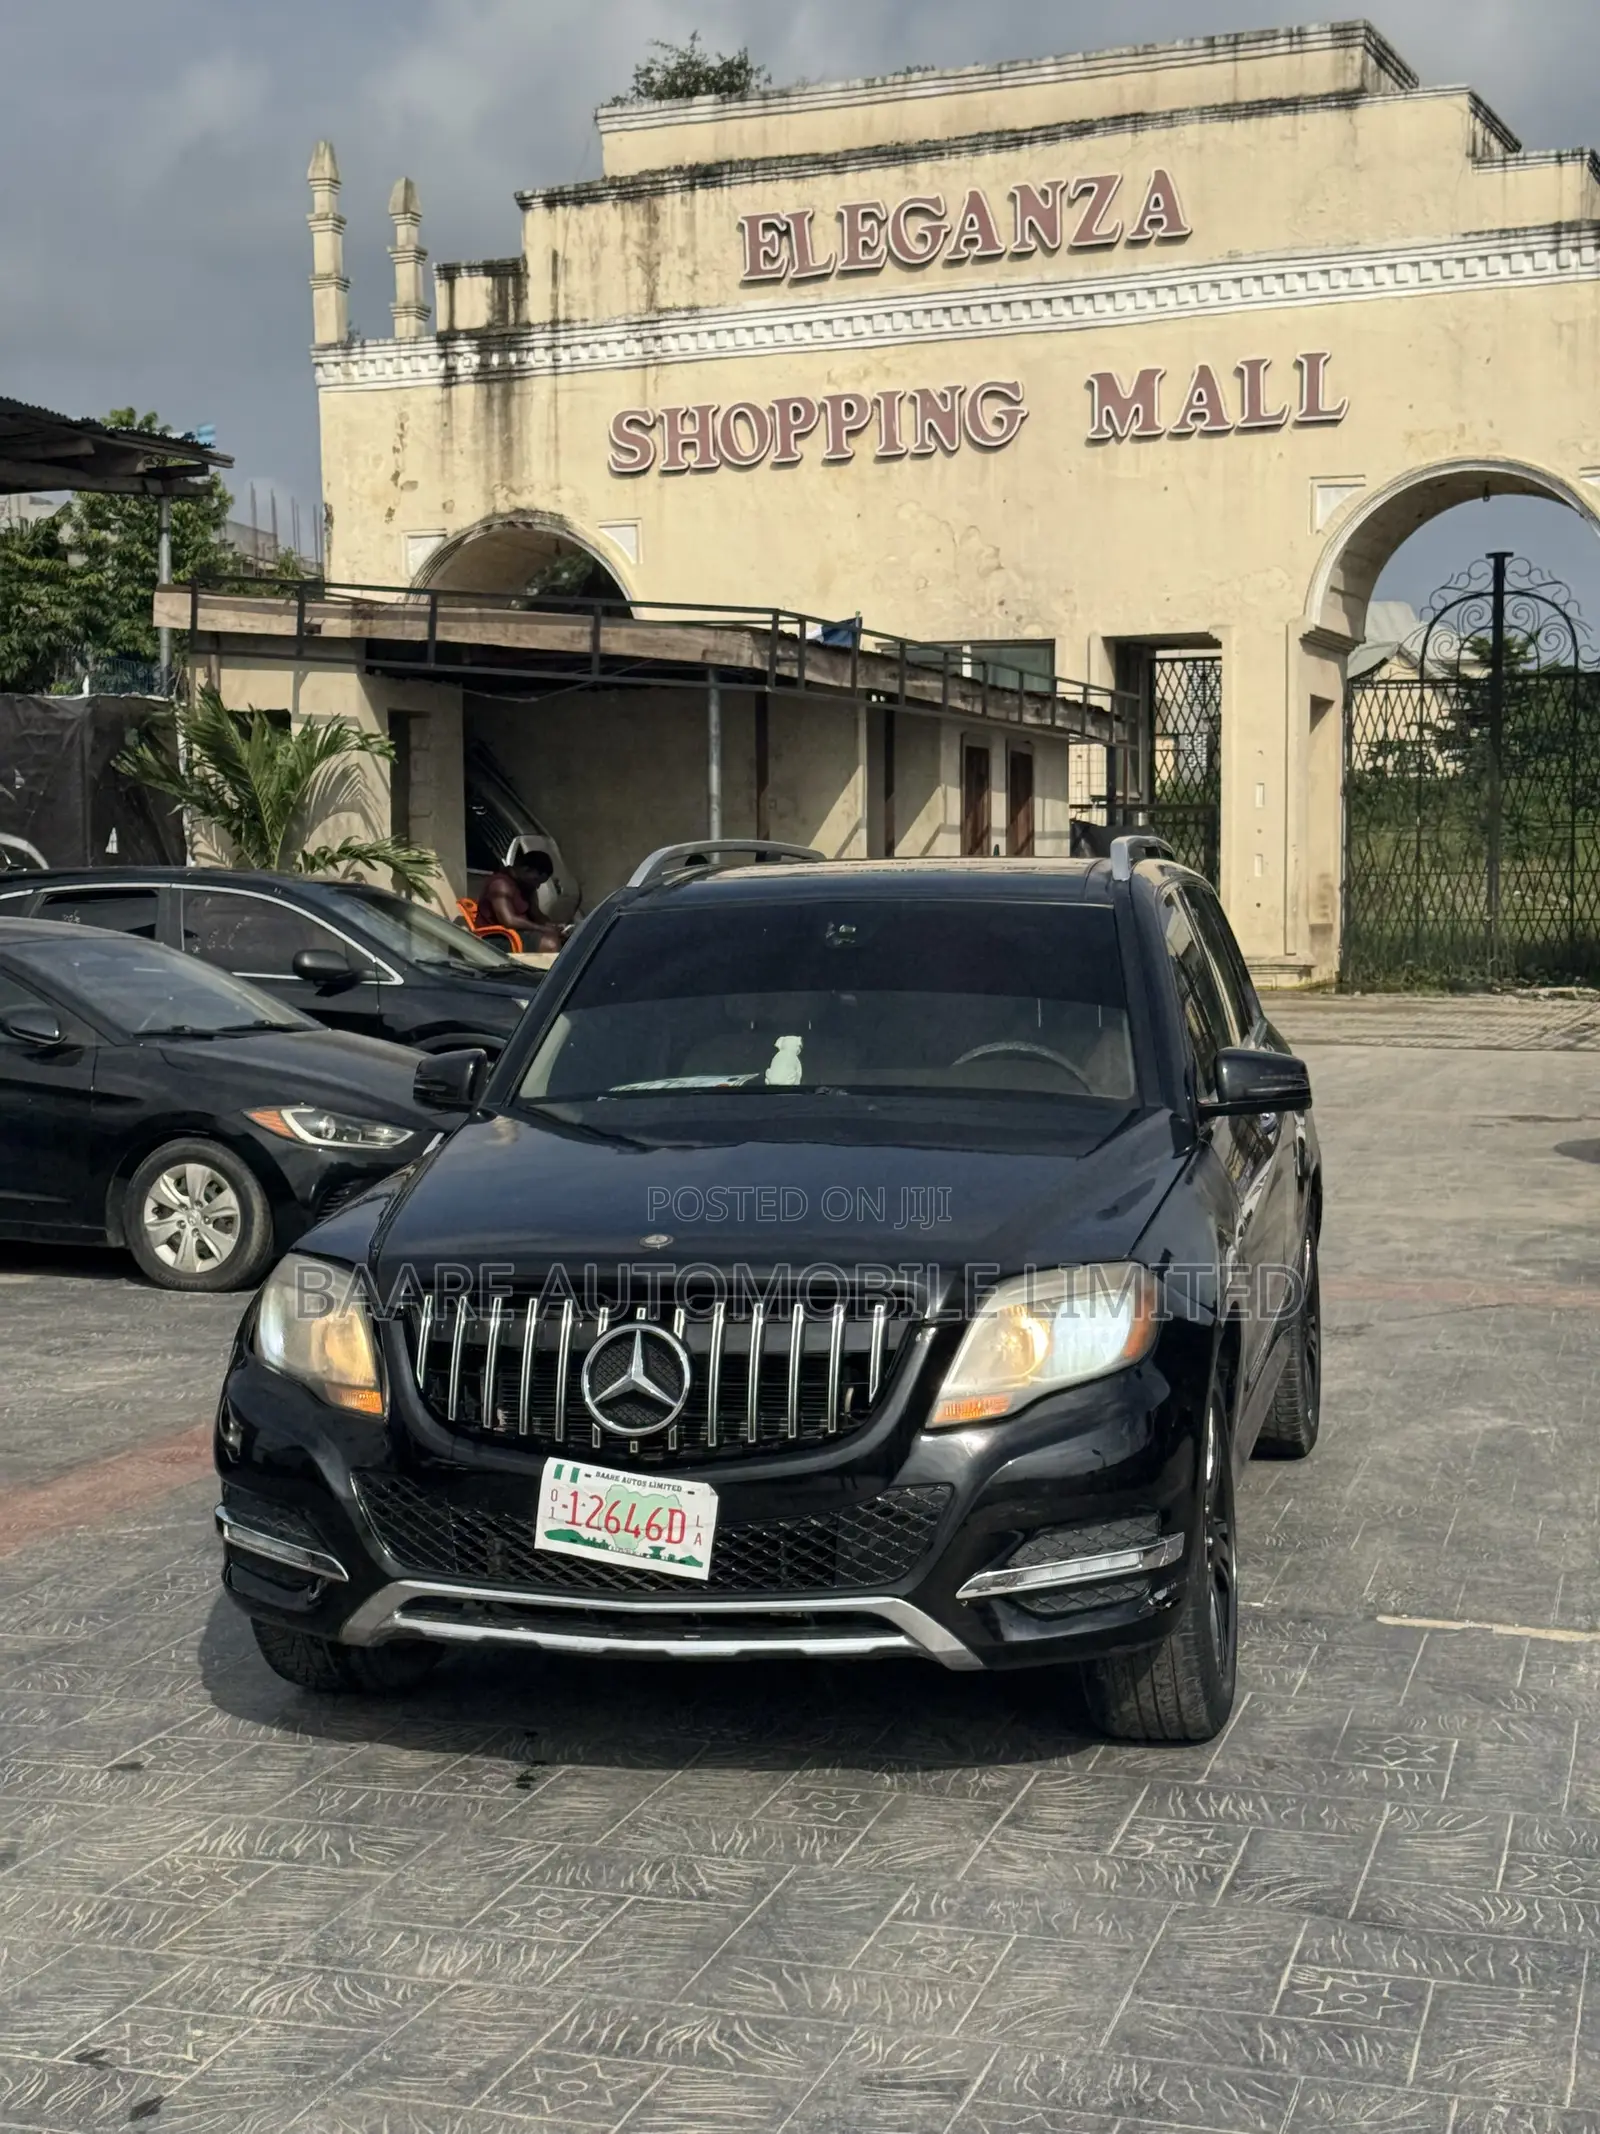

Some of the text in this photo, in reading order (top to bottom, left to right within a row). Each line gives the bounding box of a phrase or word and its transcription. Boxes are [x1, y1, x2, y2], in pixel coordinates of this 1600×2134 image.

[739, 169, 1192, 282] ELEGANZA
[608, 351, 1349, 475] SHOPPING MALL
[621, 1477, 647, 1488] AUTOS
[648, 1481, 683, 1493] LIMITED
